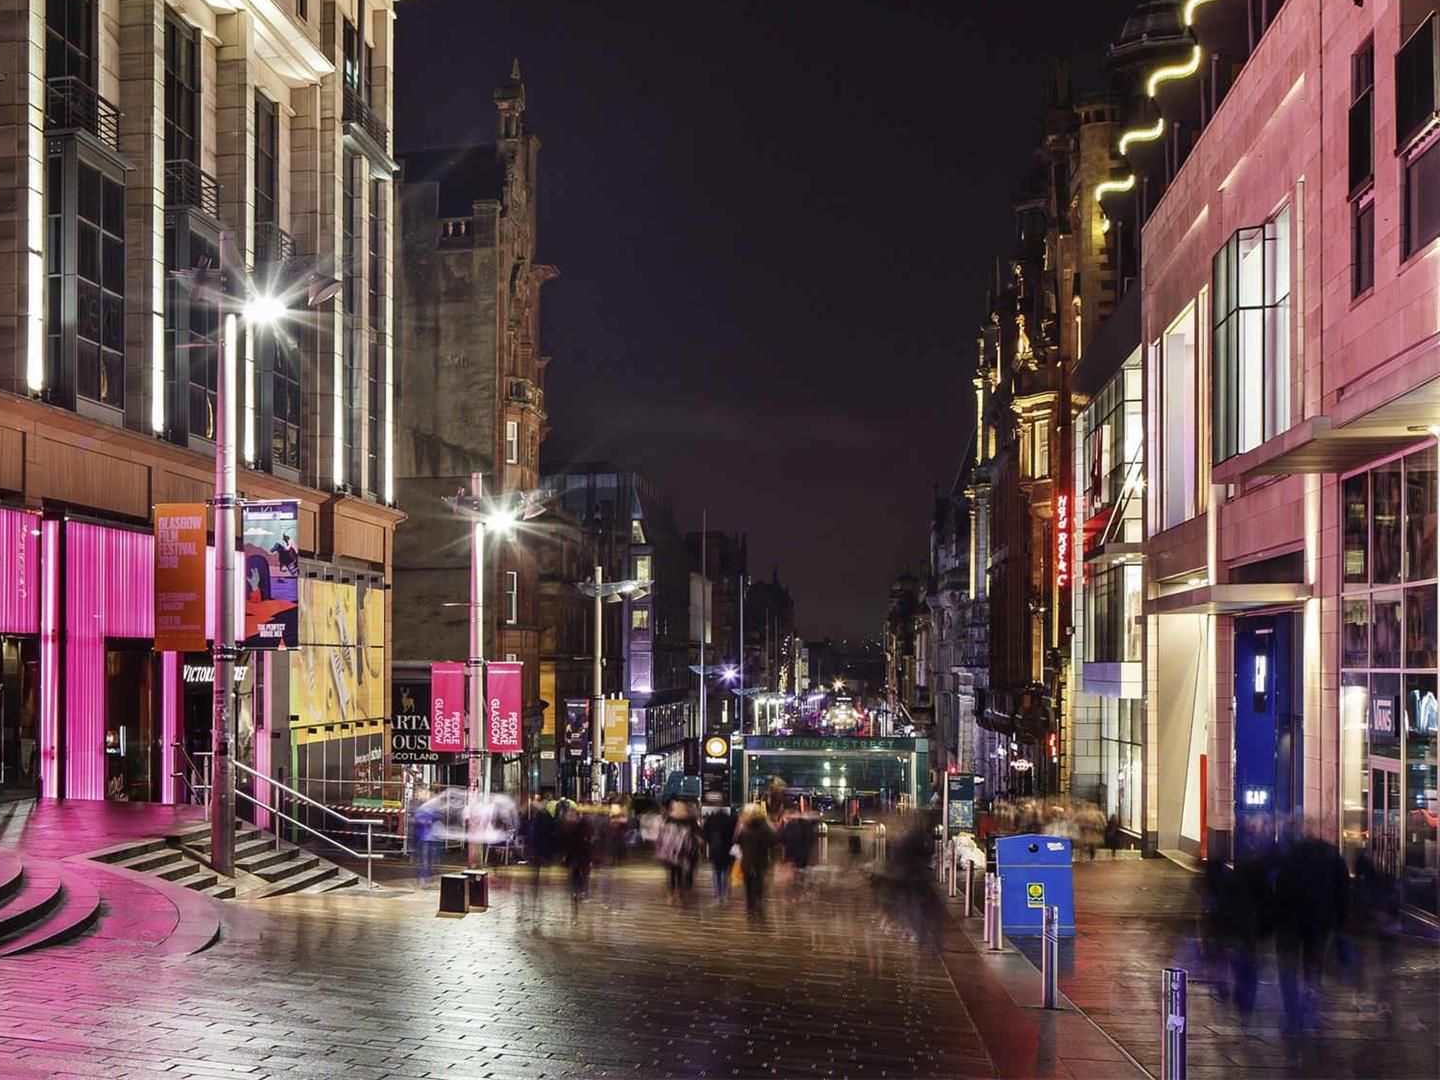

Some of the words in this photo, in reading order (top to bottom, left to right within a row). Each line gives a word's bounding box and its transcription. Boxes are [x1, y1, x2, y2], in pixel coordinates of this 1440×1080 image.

[159, 516, 202, 529] GLASGOW
[159, 542, 197, 556] FESTIVAL
[183, 665, 215, 682] VICTORI
[391, 715, 432, 729] RTA
[435, 699, 444, 744] GLASGOW
[452, 712, 460, 745] PEOPLE
[491, 699, 500, 745] GLASGOW
[509, 712, 517, 745] PEOPLE
[1372, 699, 1392, 732] VANS
[392, 735, 432, 750] OUS
[443, 719, 452, 745] MAKE
[500, 719, 509, 745] MAKE
